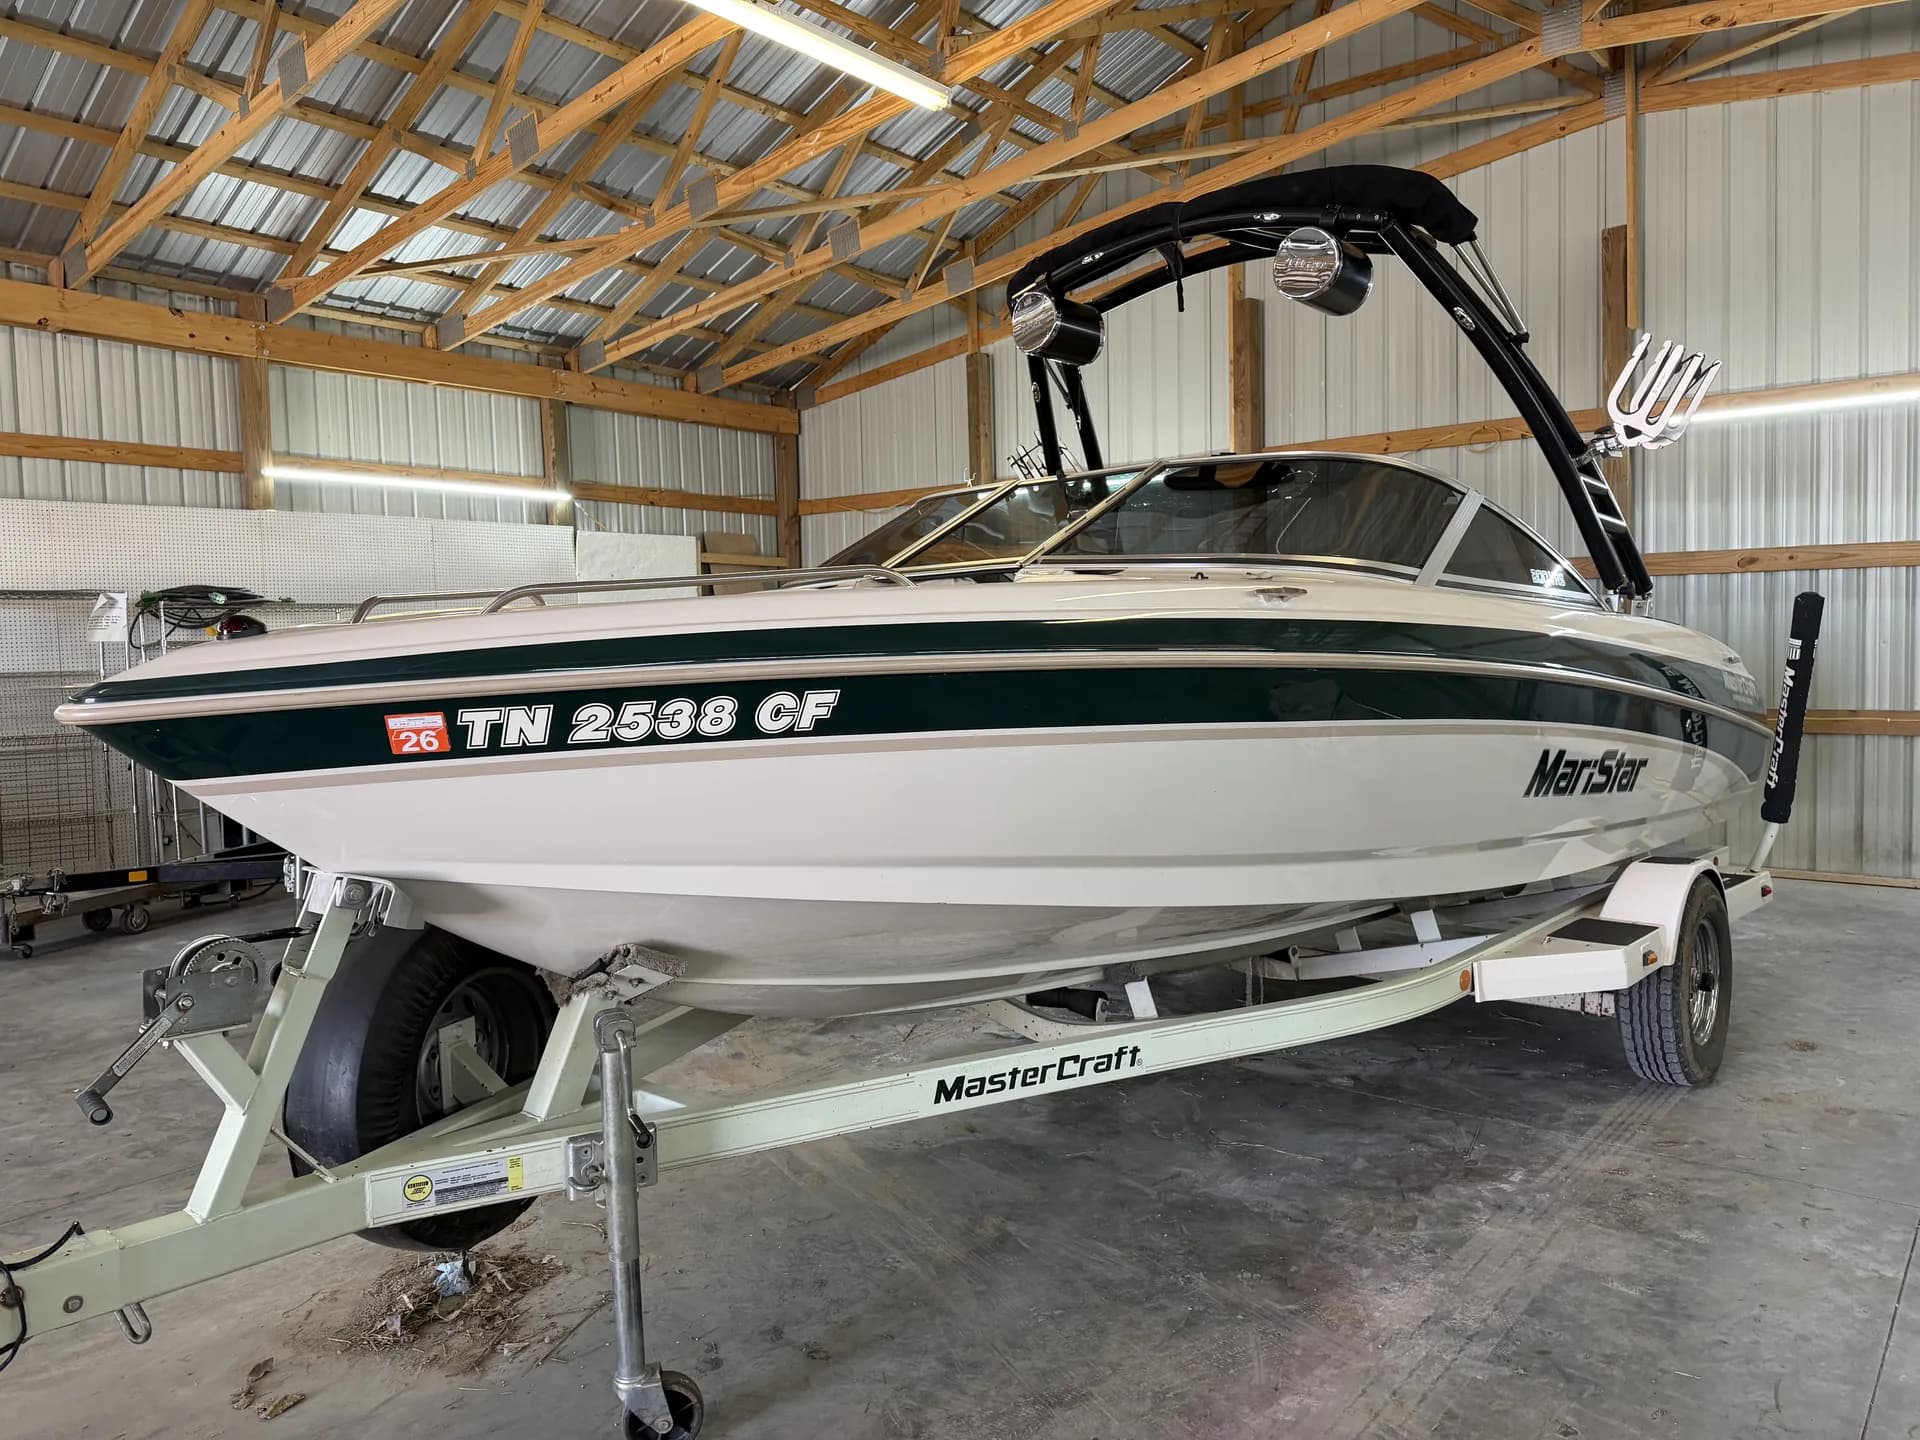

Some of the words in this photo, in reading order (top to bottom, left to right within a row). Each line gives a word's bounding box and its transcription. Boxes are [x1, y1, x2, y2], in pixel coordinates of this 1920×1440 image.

[400, 730, 439, 752] 26
[456, 704, 553, 750] TN
[567, 696, 738, 745] 2538
[755, 690, 840, 734] CF
[1766, 666, 1796, 789] MasterCraft
[1522, 749, 1649, 798] MariStar
